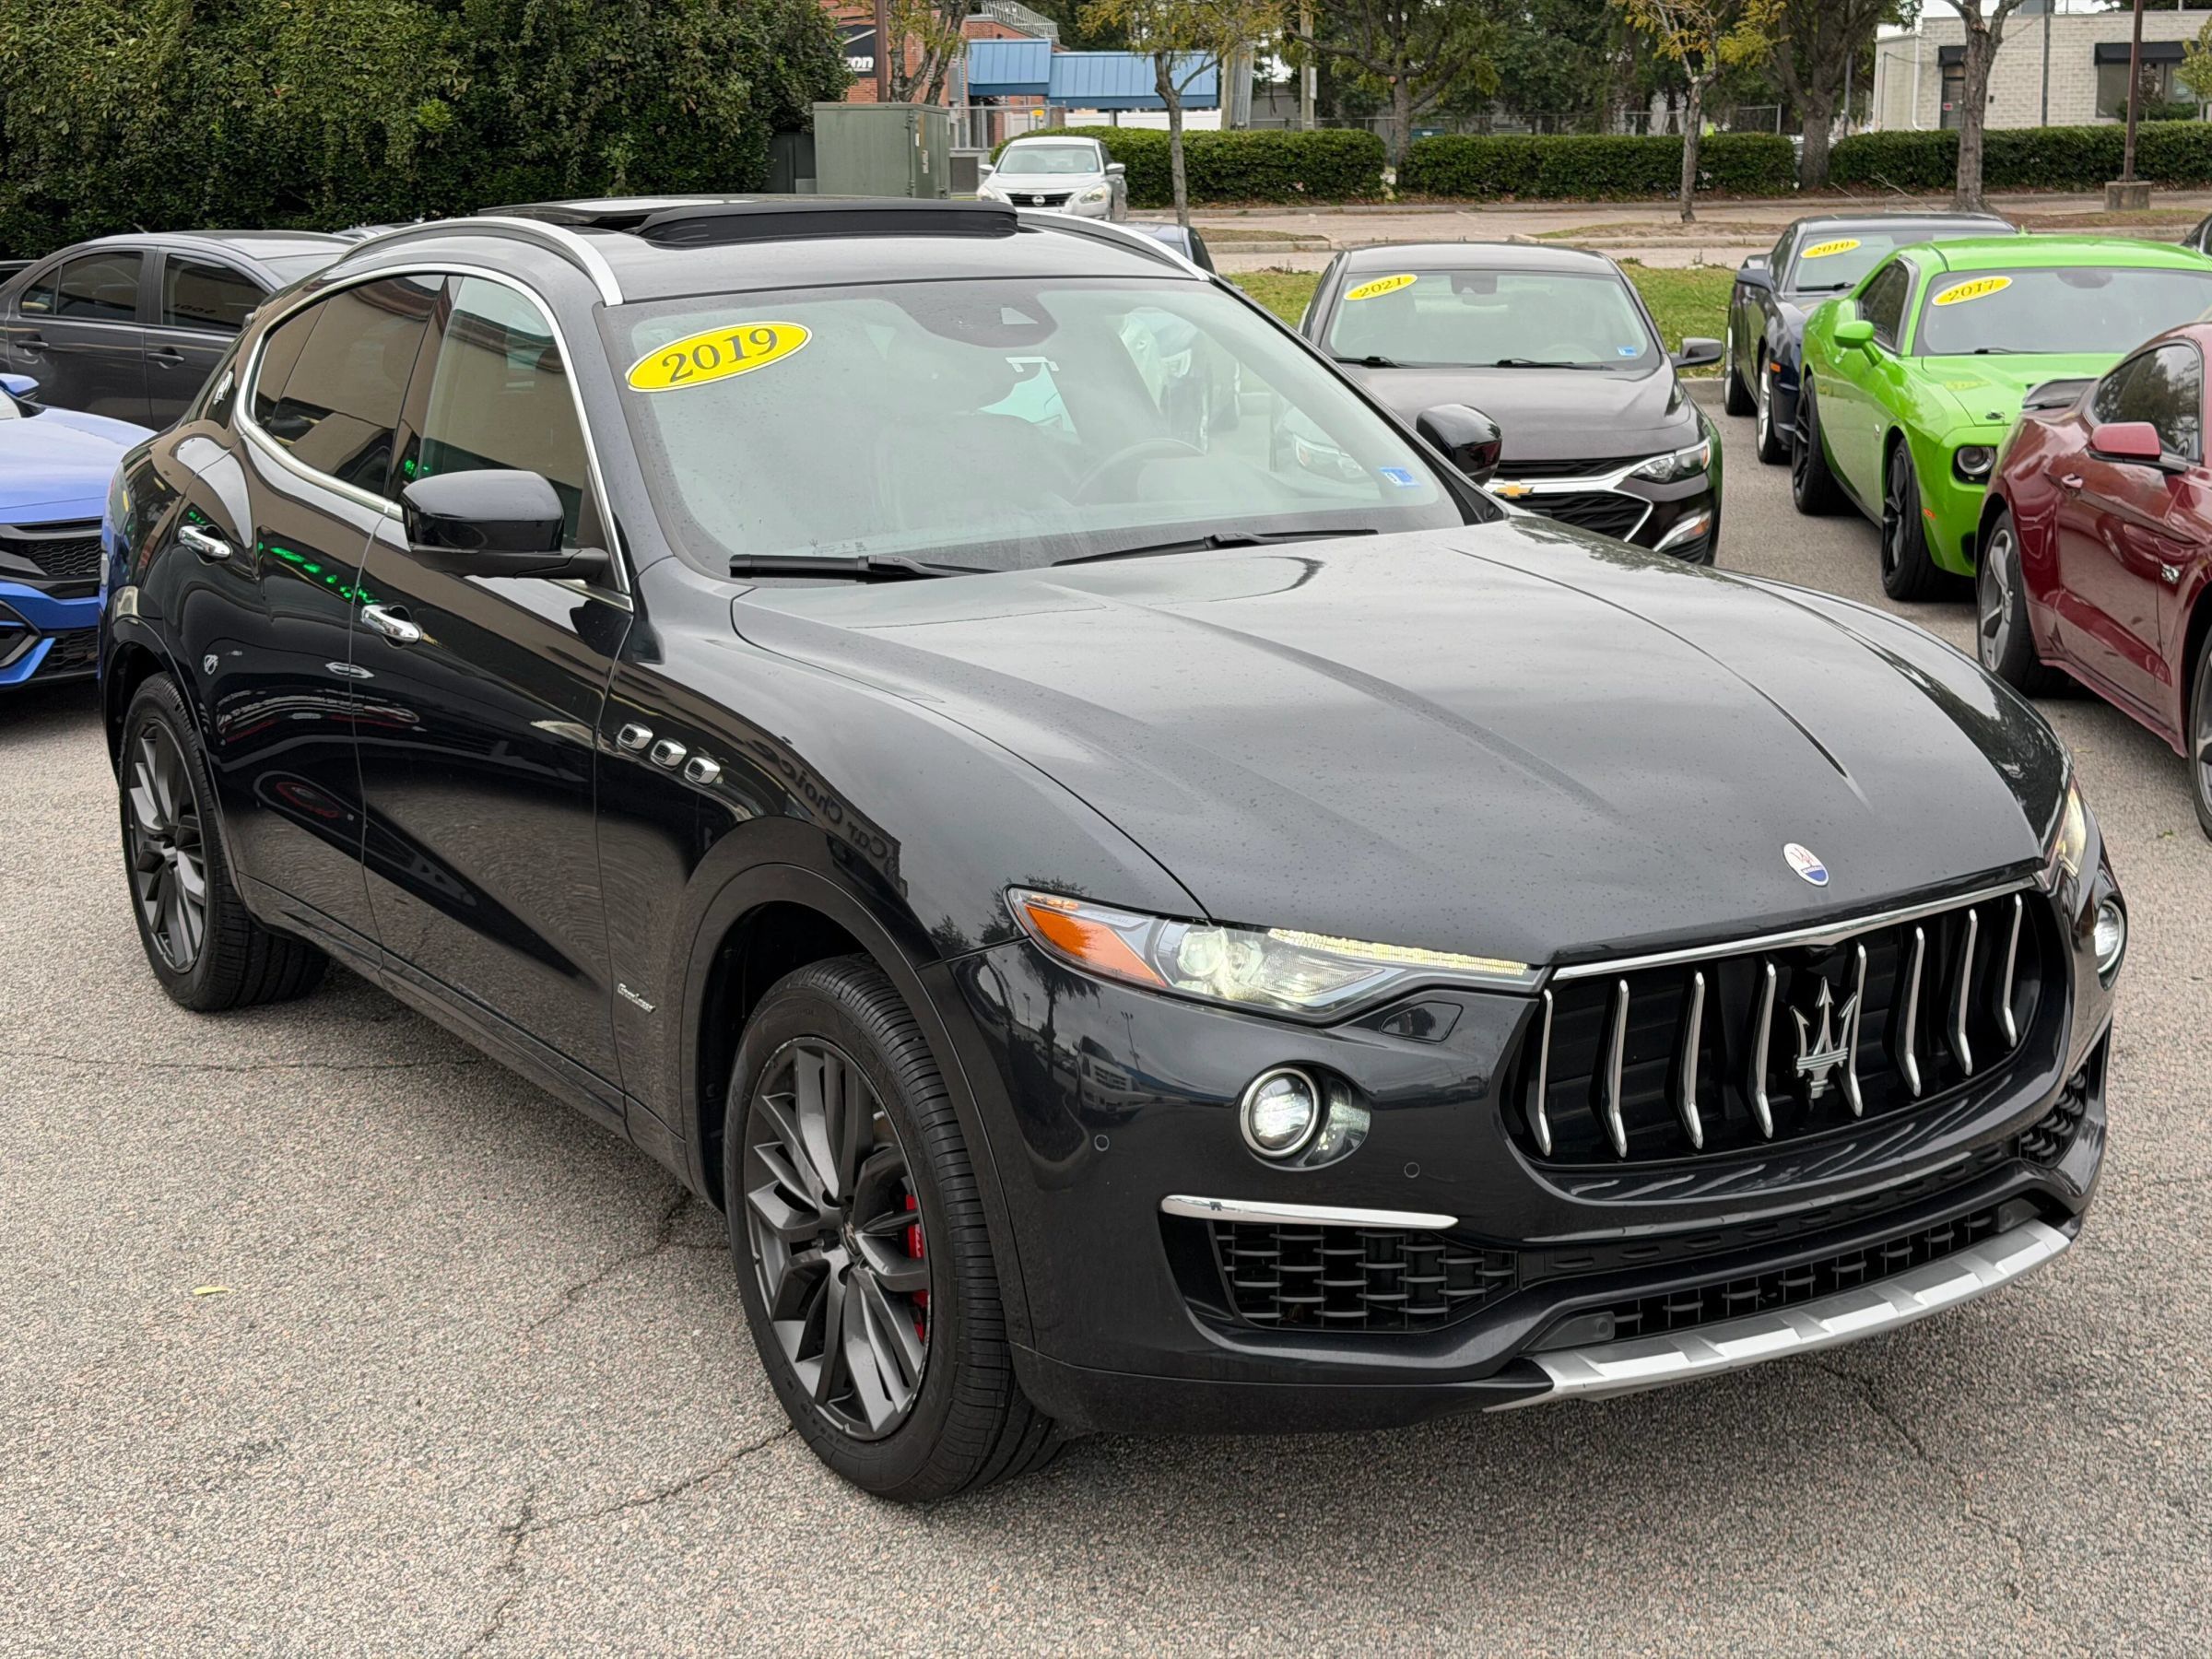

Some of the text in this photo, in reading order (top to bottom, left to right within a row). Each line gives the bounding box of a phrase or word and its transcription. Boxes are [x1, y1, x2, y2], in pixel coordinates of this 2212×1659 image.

[1359, 277, 1403, 297] 2021
[1947, 279, 1994, 301] 2017
[662, 327, 778, 383] 2019
